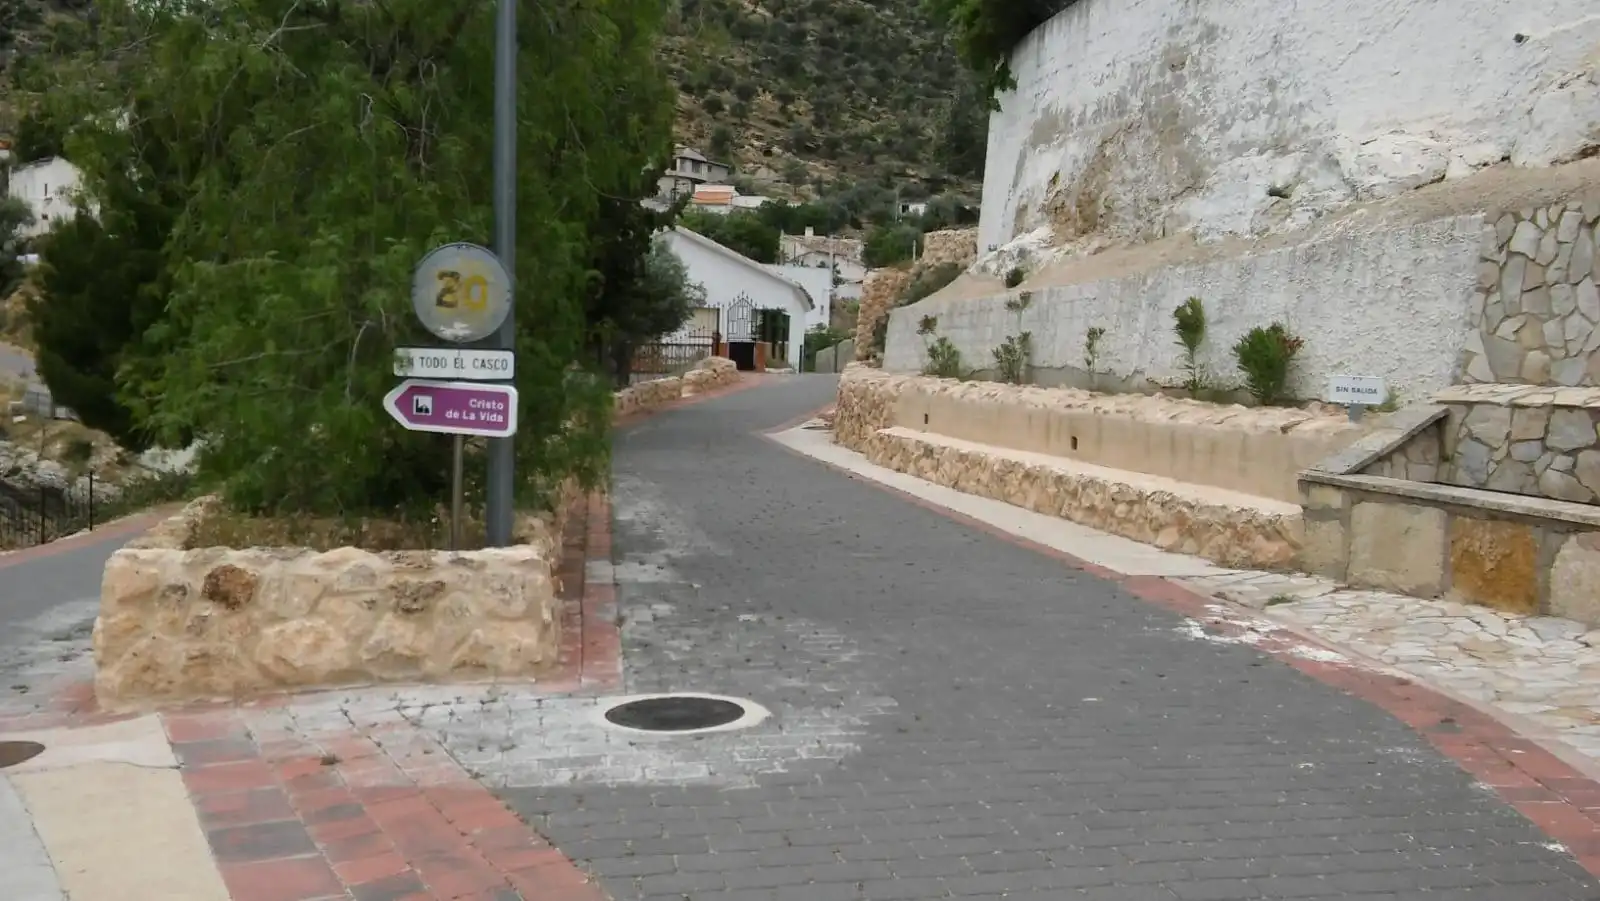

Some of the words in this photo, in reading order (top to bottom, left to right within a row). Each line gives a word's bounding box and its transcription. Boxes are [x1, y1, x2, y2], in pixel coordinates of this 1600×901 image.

[435, 269, 489, 311] 20
[419, 356, 447, 368] TODO
[454, 358, 465, 369] EL
[473, 359, 508, 371] CASCO
[469, 398, 504, 410] Cristo
[445, 409, 459, 419] de
[463, 410, 476, 420] La
[480, 411, 504, 423] Vida
